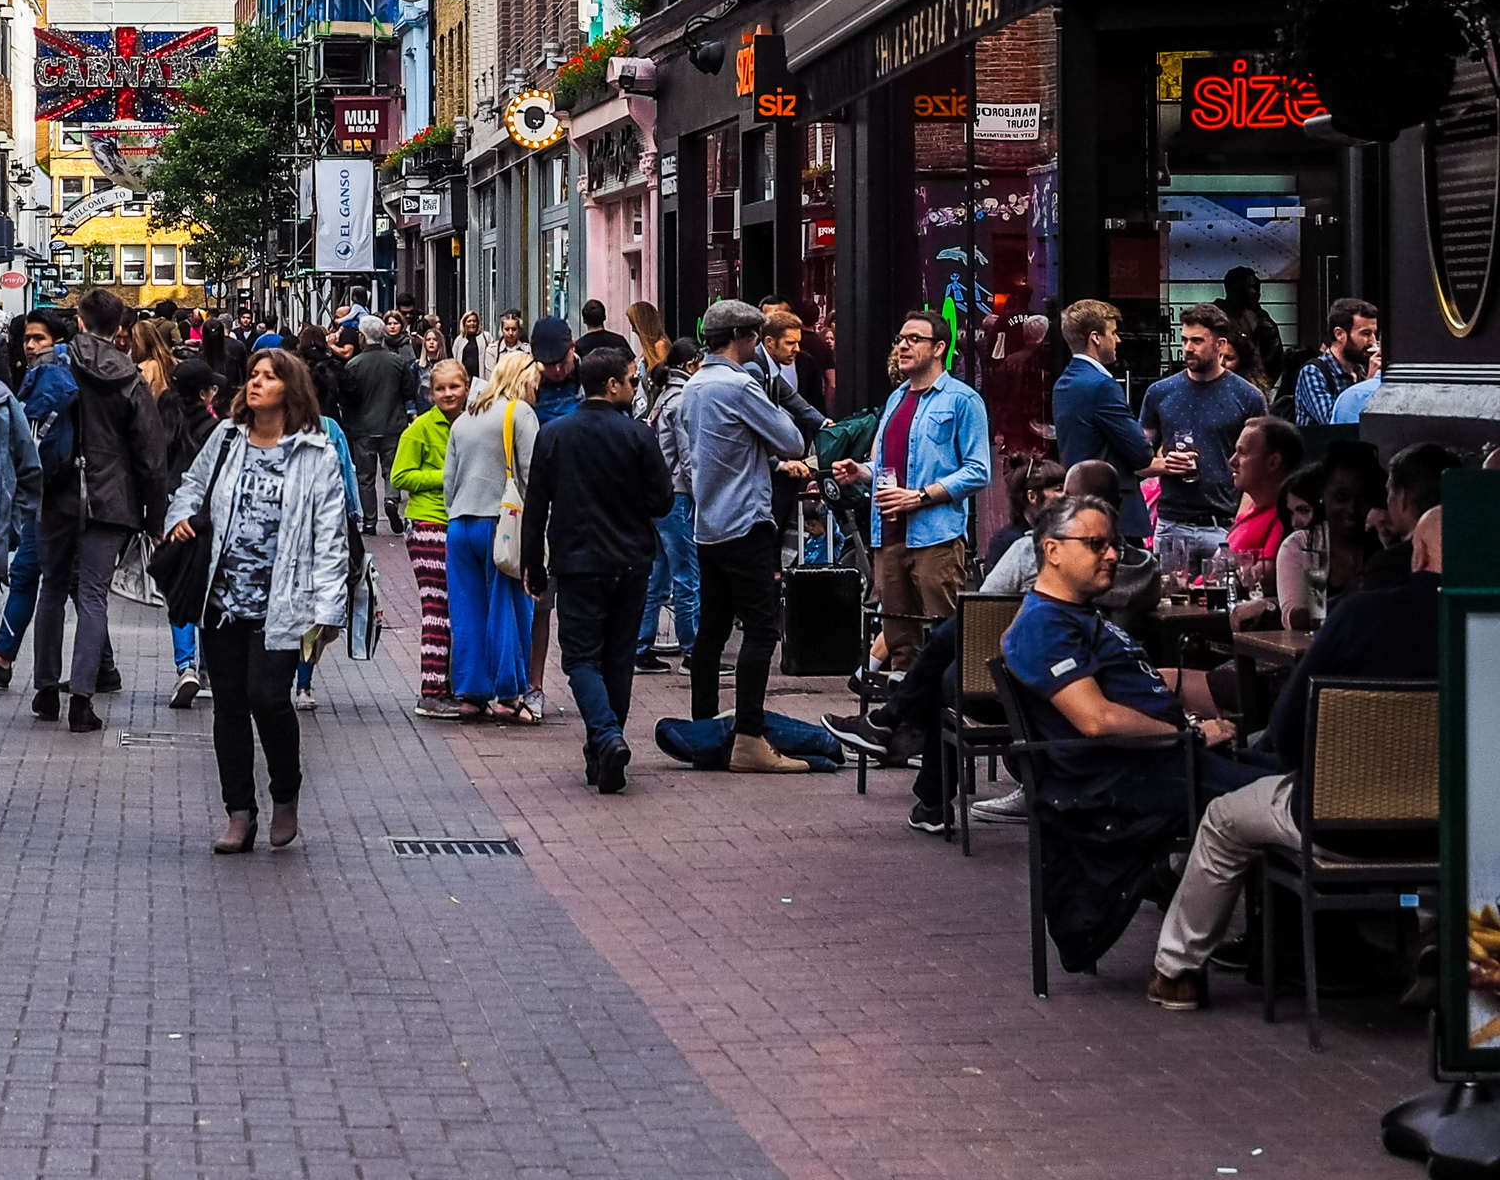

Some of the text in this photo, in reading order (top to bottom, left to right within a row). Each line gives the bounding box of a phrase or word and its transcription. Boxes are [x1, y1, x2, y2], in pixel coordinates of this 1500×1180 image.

[344, 109, 379, 125] MUJI
[758, 86, 797, 117] siz
[67, 191, 126, 222] WELCOME TO
[339, 169, 350, 237] EL GANSO
